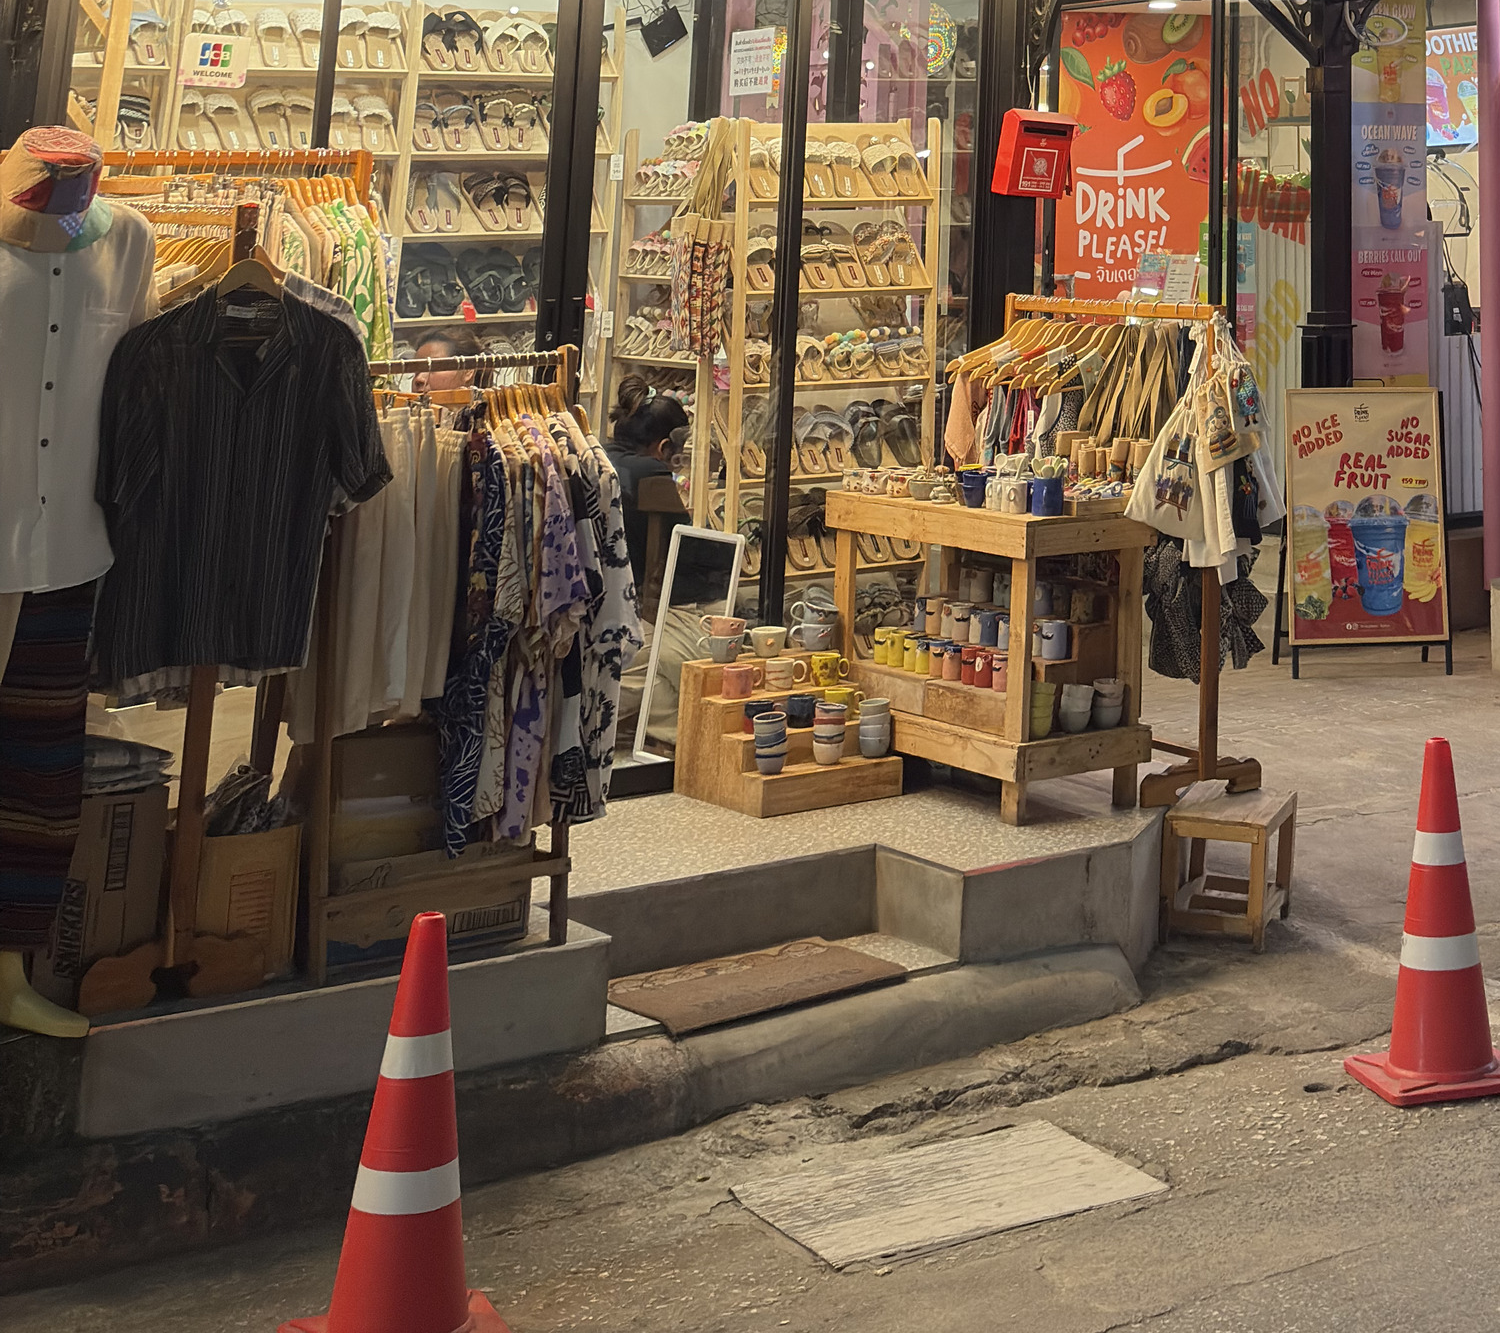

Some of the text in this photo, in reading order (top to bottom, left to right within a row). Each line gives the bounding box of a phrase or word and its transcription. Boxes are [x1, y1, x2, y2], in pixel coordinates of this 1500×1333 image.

[193, 69, 233, 79] WELCOME
[1240, 67, 1280, 138] NO
[1361, 124, 1418, 141] OCEAN WAVE
[1238, 165, 1311, 246] UGAR
[1078, 225, 1168, 265] PLEASE!
[1357, 249, 1422, 264] BERRIES CALL OUT
[1292, 413, 1341, 446] NO ICE
[1400, 416, 1420, 430] NO
[1298, 429, 1344, 459] ADDED
[1386, 429, 1432, 447] SUGAR
[1339, 452, 1388, 473] REAL
[1386, 445, 1430, 460] ADDED
[1334, 470, 1392, 490] FRUIT
